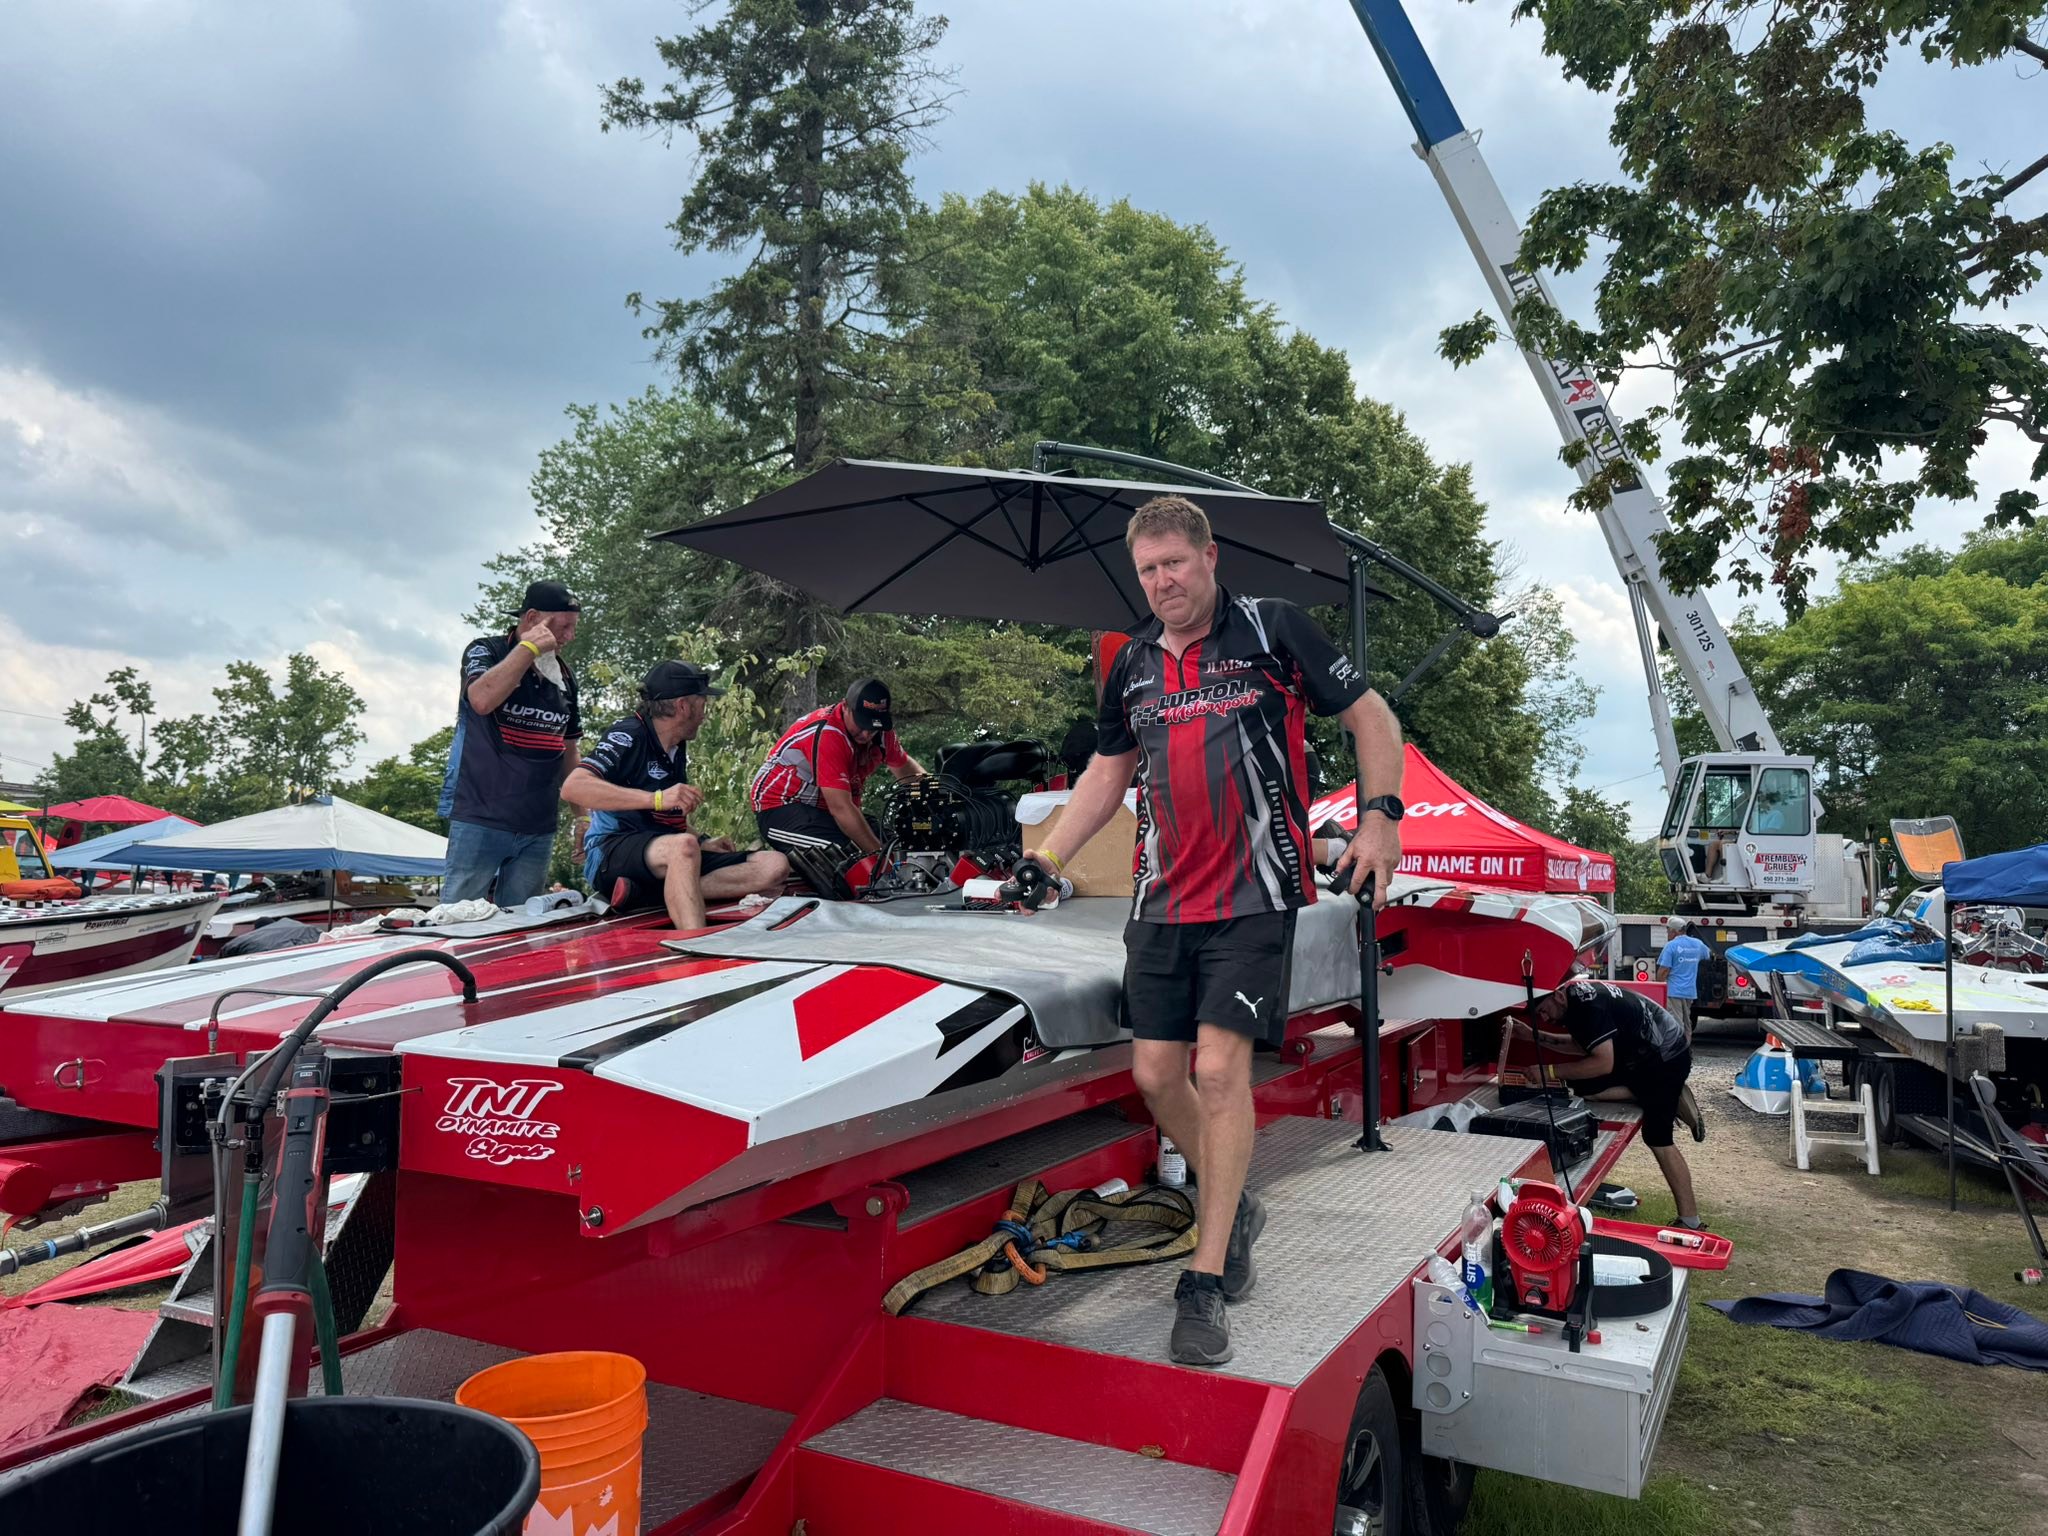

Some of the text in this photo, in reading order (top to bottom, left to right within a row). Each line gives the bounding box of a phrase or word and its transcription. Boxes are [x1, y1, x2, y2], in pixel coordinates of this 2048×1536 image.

[1686, 610, 1715, 652] 30112S
[1158, 680, 1249, 708] LUPTON
[1160, 688, 1263, 723] Motorsport
[502, 702, 567, 724] LUPTON
[1309, 796, 1468, 832] Moon
[1427, 856, 1475, 875] NAME
[1480, 856, 1504, 876] ON
[1509, 857, 1525, 876] IT
[1760, 854, 1801, 863] TREMBLAY
[1767, 862, 1793, 871] GRUES
[443, 1077, 564, 1120] TNT
[435, 1115, 561, 1139] DYNAMITE
[465, 1136, 556, 1166] Signs
[1466, 1242, 1477, 1284] smart
